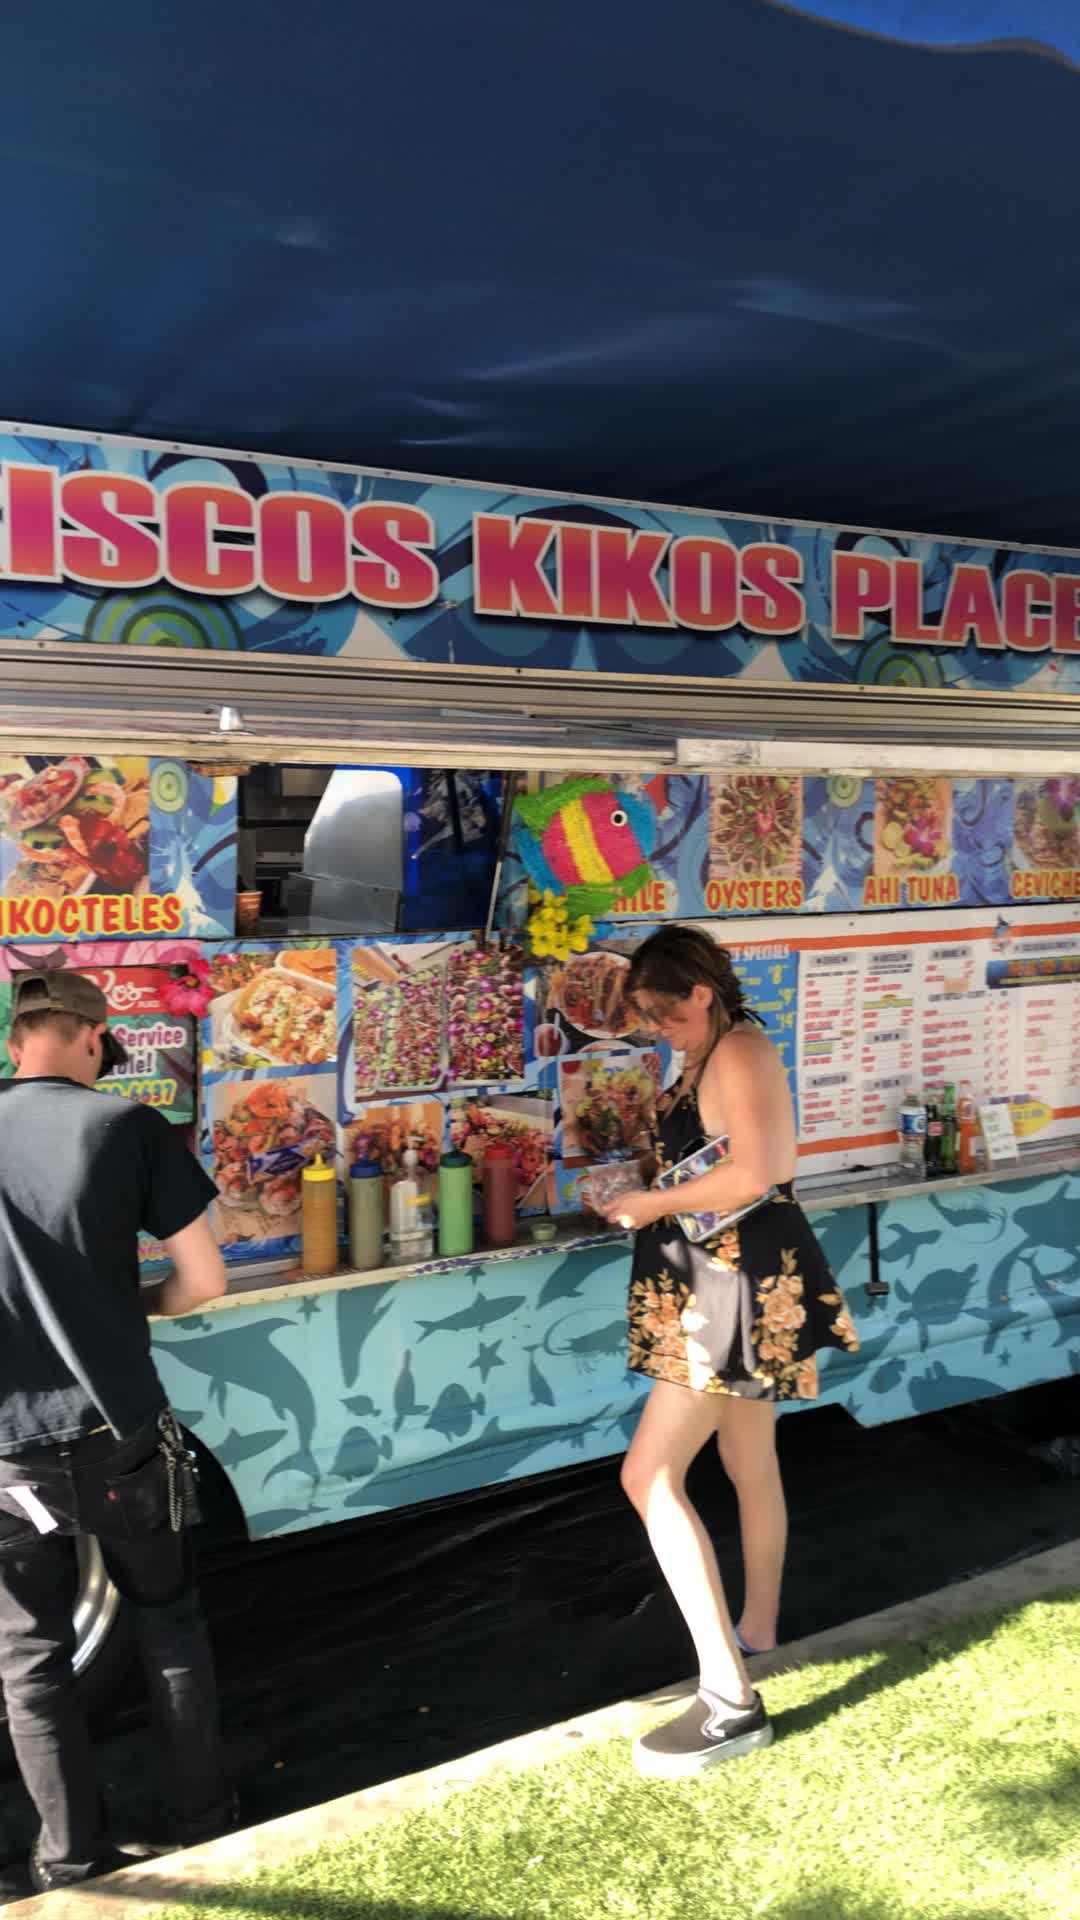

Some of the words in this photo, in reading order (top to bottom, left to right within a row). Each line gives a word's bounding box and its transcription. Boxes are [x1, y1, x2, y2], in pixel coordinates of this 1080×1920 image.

[0, 462, 440, 609] ISCOS
[472, 511, 806, 635] KIKOS
[831, 549, 1080, 654] PLACE
[705, 879, 803, 912] OYSTERS
[865, 876, 899, 905] AHI
[905, 873, 960, 903] TUNA
[0, 895, 182, 937] KOCTELES
[113, 1023, 186, 1049] Service
